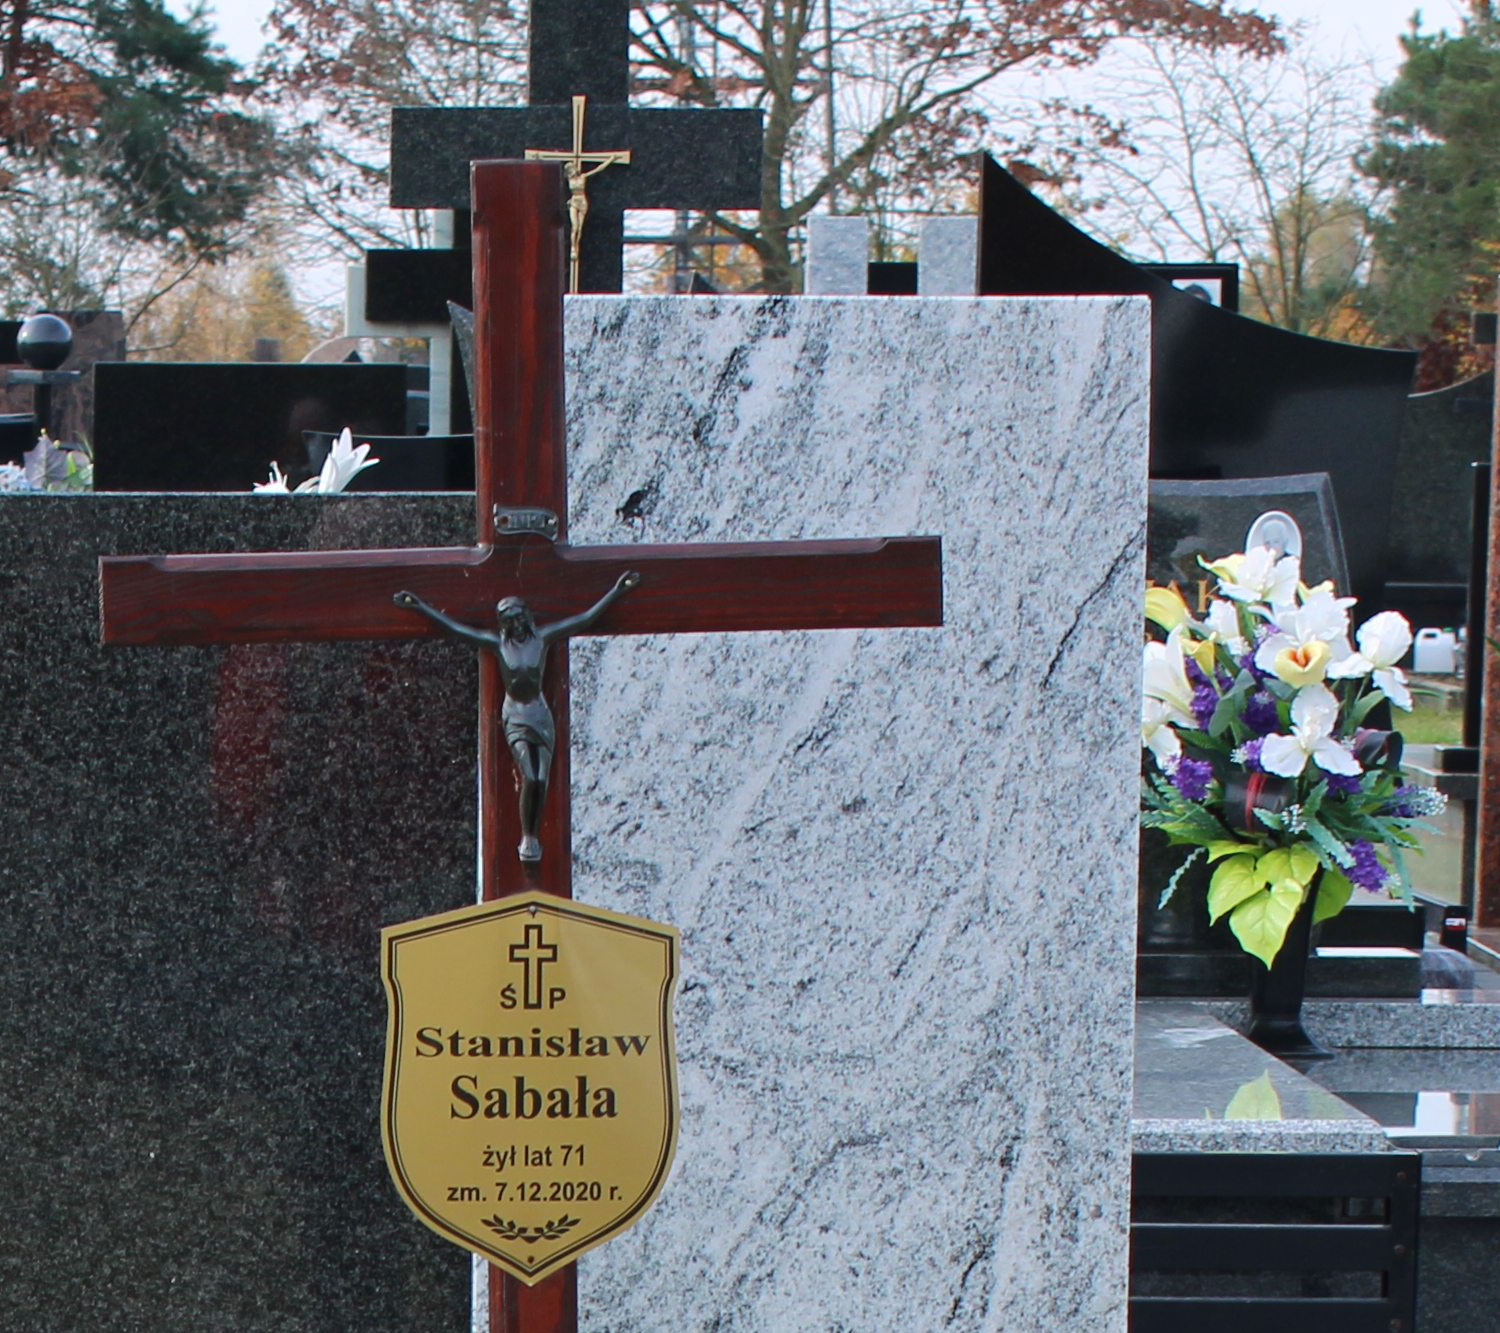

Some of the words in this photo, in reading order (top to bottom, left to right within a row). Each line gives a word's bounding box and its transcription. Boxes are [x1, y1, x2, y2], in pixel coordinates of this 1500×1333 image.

[548, 987, 567, 1009] P
[415, 1027, 651, 1058] Stanisław
[449, 1074, 618, 1120] Sabała
[481, 1145, 517, 1172] żył
[523, 1145, 553, 1167] lat
[560, 1145, 586, 1167] 71
[447, 1185, 487, 1202] zm.
[495, 1182, 601, 1202] 7.12.2020
[609, 1185, 623, 1201] r.
